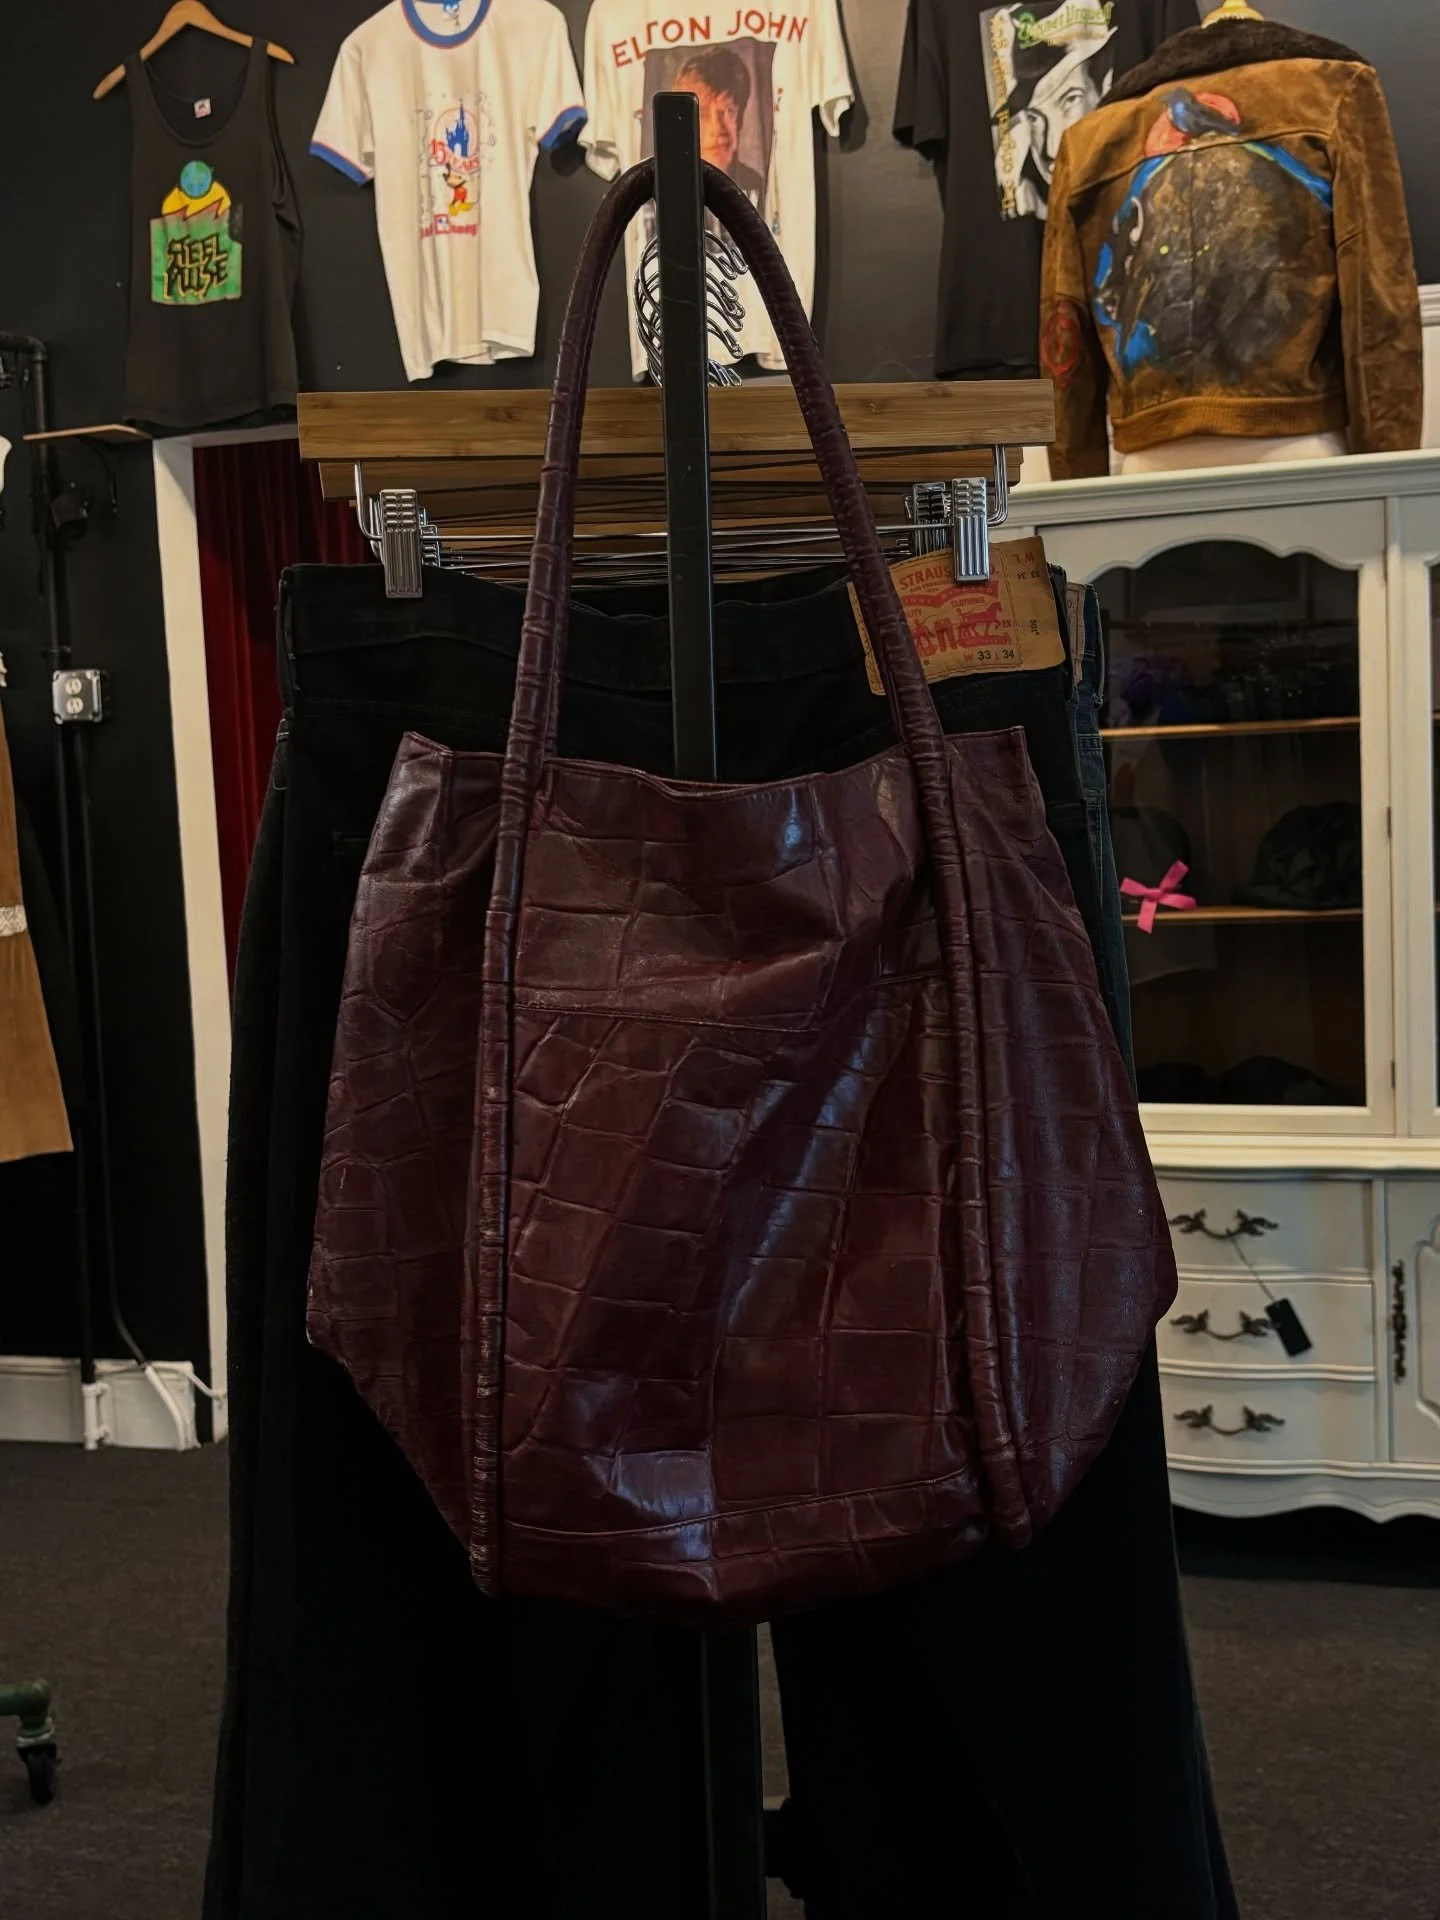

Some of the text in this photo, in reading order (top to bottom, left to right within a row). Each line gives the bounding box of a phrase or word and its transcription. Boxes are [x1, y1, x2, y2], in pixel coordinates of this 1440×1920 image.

[611, 9, 808, 67] ELTON JOHN
[900, 564, 953, 590] STRAUS
[977, 650, 992, 661] 33
[1002, 649, 1015, 660] 34
